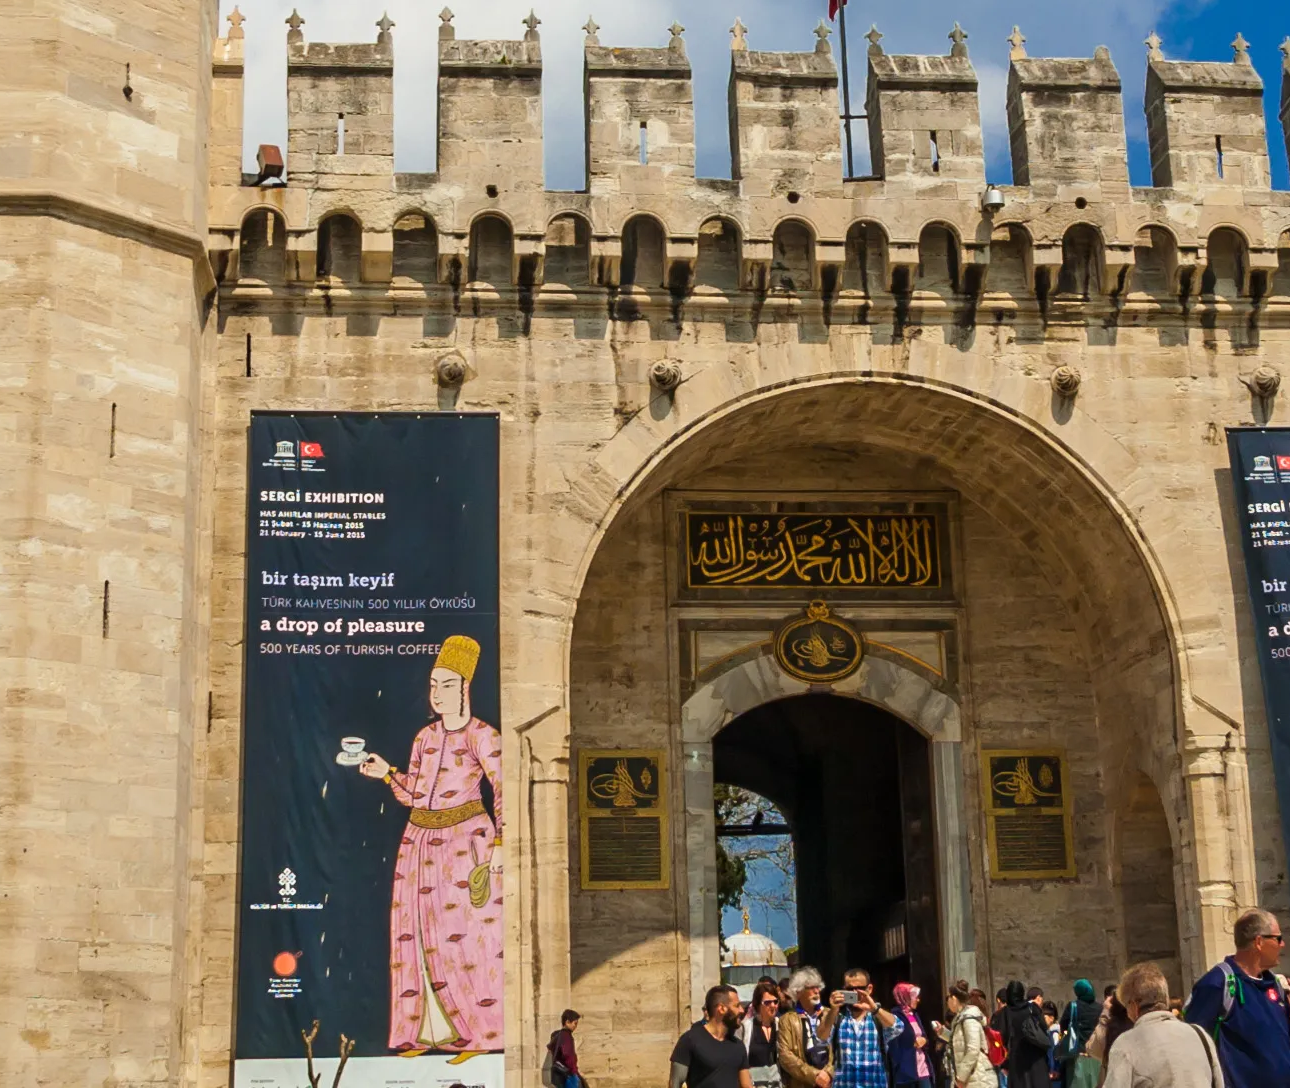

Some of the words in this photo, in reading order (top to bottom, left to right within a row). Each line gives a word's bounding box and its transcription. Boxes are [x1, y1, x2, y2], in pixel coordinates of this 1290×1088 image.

[260, 489, 300, 502] SERGİ
[305, 493, 384, 503] EXHIBITION
[1247, 500, 1285, 514] SERGİ
[262, 571, 287, 586] bir
[293, 572, 343, 590] taşım
[348, 573, 394, 590] keyif
[1261, 579, 1287, 593] bir
[262, 596, 292, 608] TÜRK
[368, 599, 389, 609] 500
[392, 599, 426, 609] YILLIK
[429, 596, 476, 609] ÖYKÜSÜ
[260, 619, 271, 631] a
[276, 617, 318, 635] drop
[324, 617, 342, 633] of
[347, 618, 425, 635] pleasure
[1268, 626, 1279, 637] a
[260, 643, 282, 654] 500
[285, 644, 321, 655] YEARS
[324, 644, 341, 655] OF
[344, 644, 394, 655] TURKISH
[397, 644, 441, 655] COFFEE
